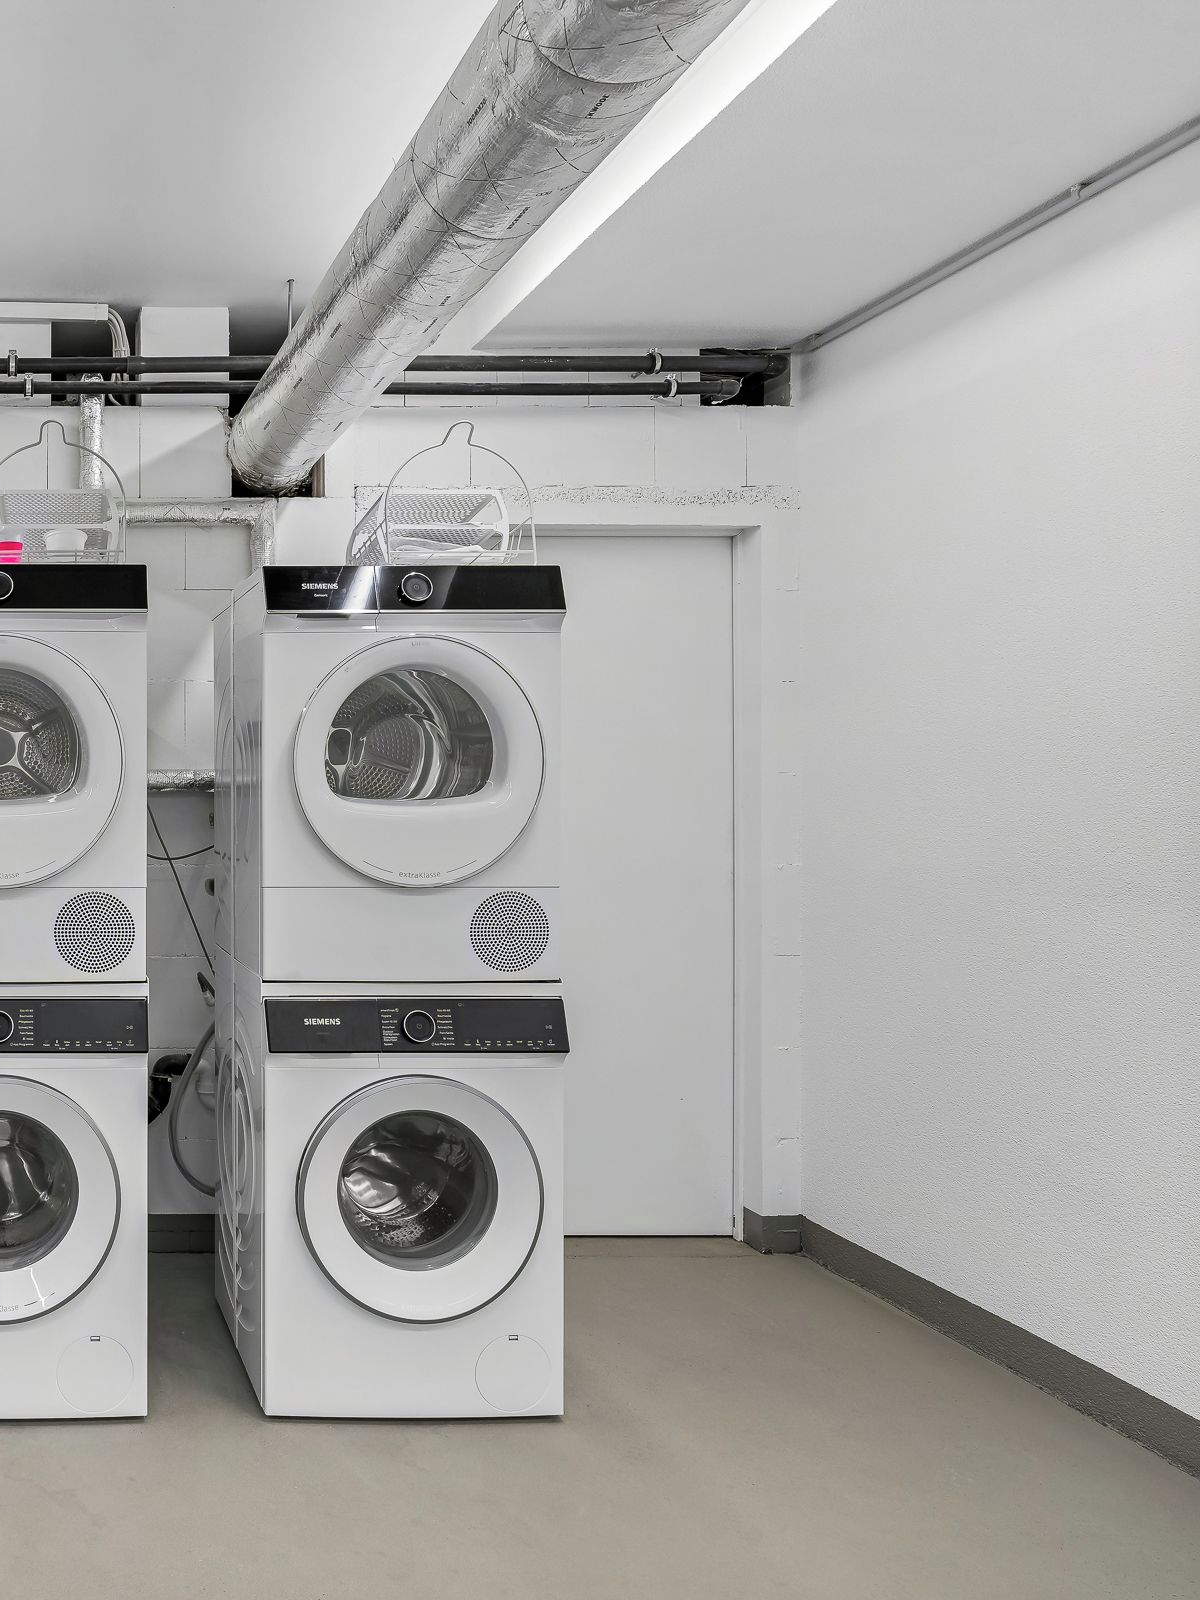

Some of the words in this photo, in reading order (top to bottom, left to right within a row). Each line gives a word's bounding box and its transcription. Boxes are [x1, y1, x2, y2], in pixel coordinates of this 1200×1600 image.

[301, 582, 339, 590] SIEMENS
[398, 871, 441, 879] extraKlasse
[303, 1017, 341, 1026] SIEMENS
